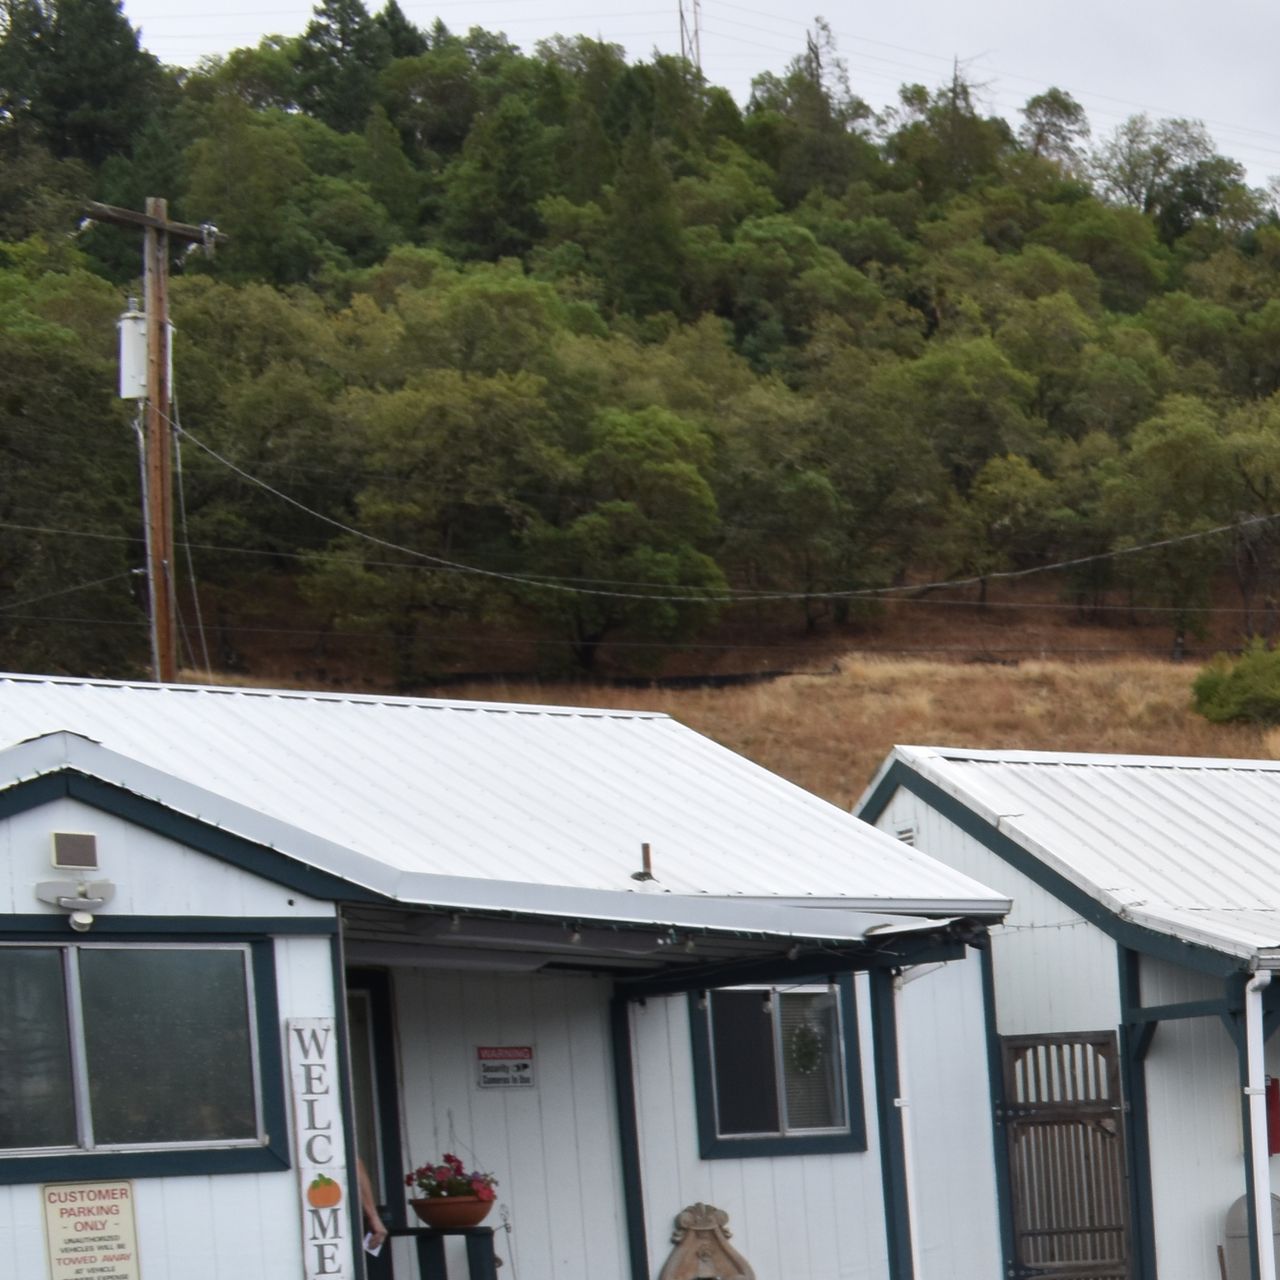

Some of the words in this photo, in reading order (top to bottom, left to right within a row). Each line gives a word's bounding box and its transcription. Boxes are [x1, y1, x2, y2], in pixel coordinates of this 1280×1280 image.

[480, 1048, 530, 1058] WARNING
[482, 1063, 510, 1073] Security
[48, 1188, 129, 1204] CUSTOMER
[60, 1204, 120, 1218] PARKING
[74, 1220, 107, 1232] ONLY
[63, 1235, 120, 1244] UNAUTHORIZED
[60, 1245, 95, 1253] VEHICLES
[56, 1255, 97, 1266] TOWED
[102, 1253, 131, 1263] AWAY
[87, 1266, 116, 1274] VEHICLE
